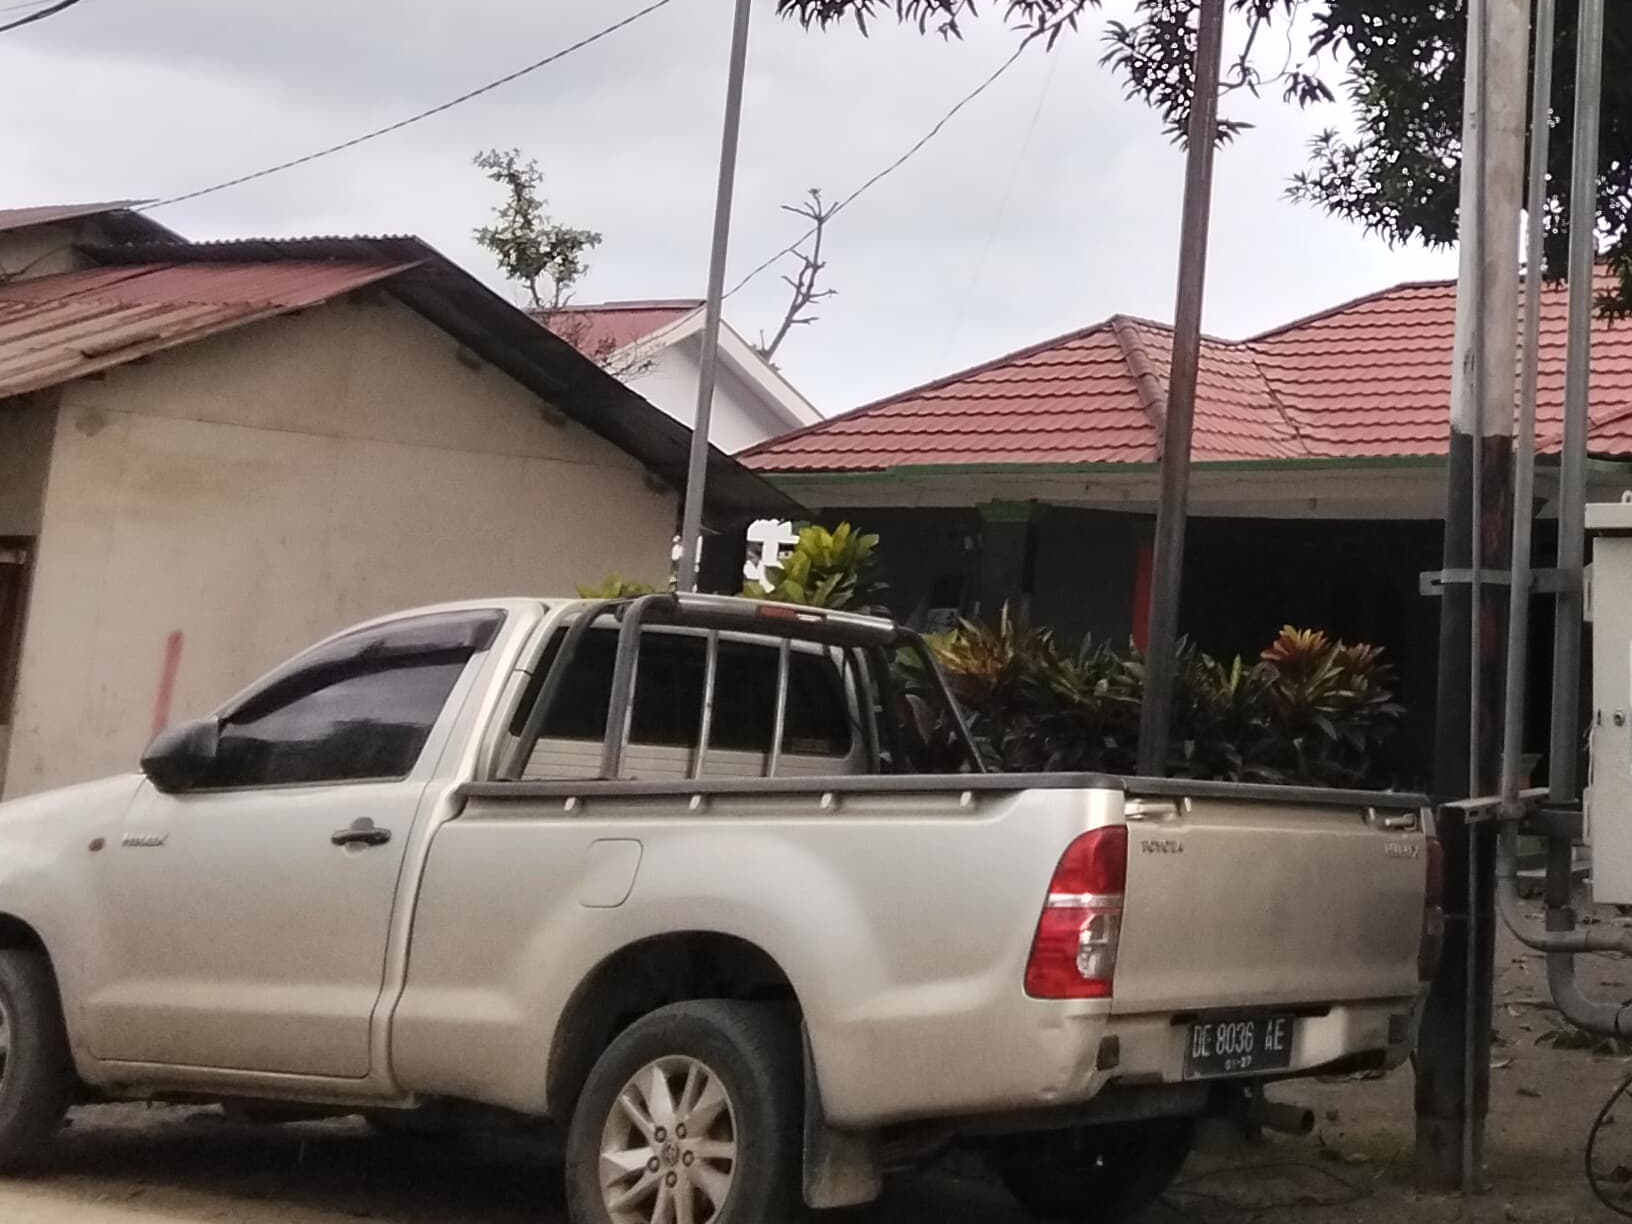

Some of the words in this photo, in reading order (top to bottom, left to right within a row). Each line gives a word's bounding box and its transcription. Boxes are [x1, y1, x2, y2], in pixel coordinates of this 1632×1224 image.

[1192, 1023, 1211, 1058] DE
[1216, 1020, 1255, 1055] 8036
[1264, 1018, 1285, 1050] AE
